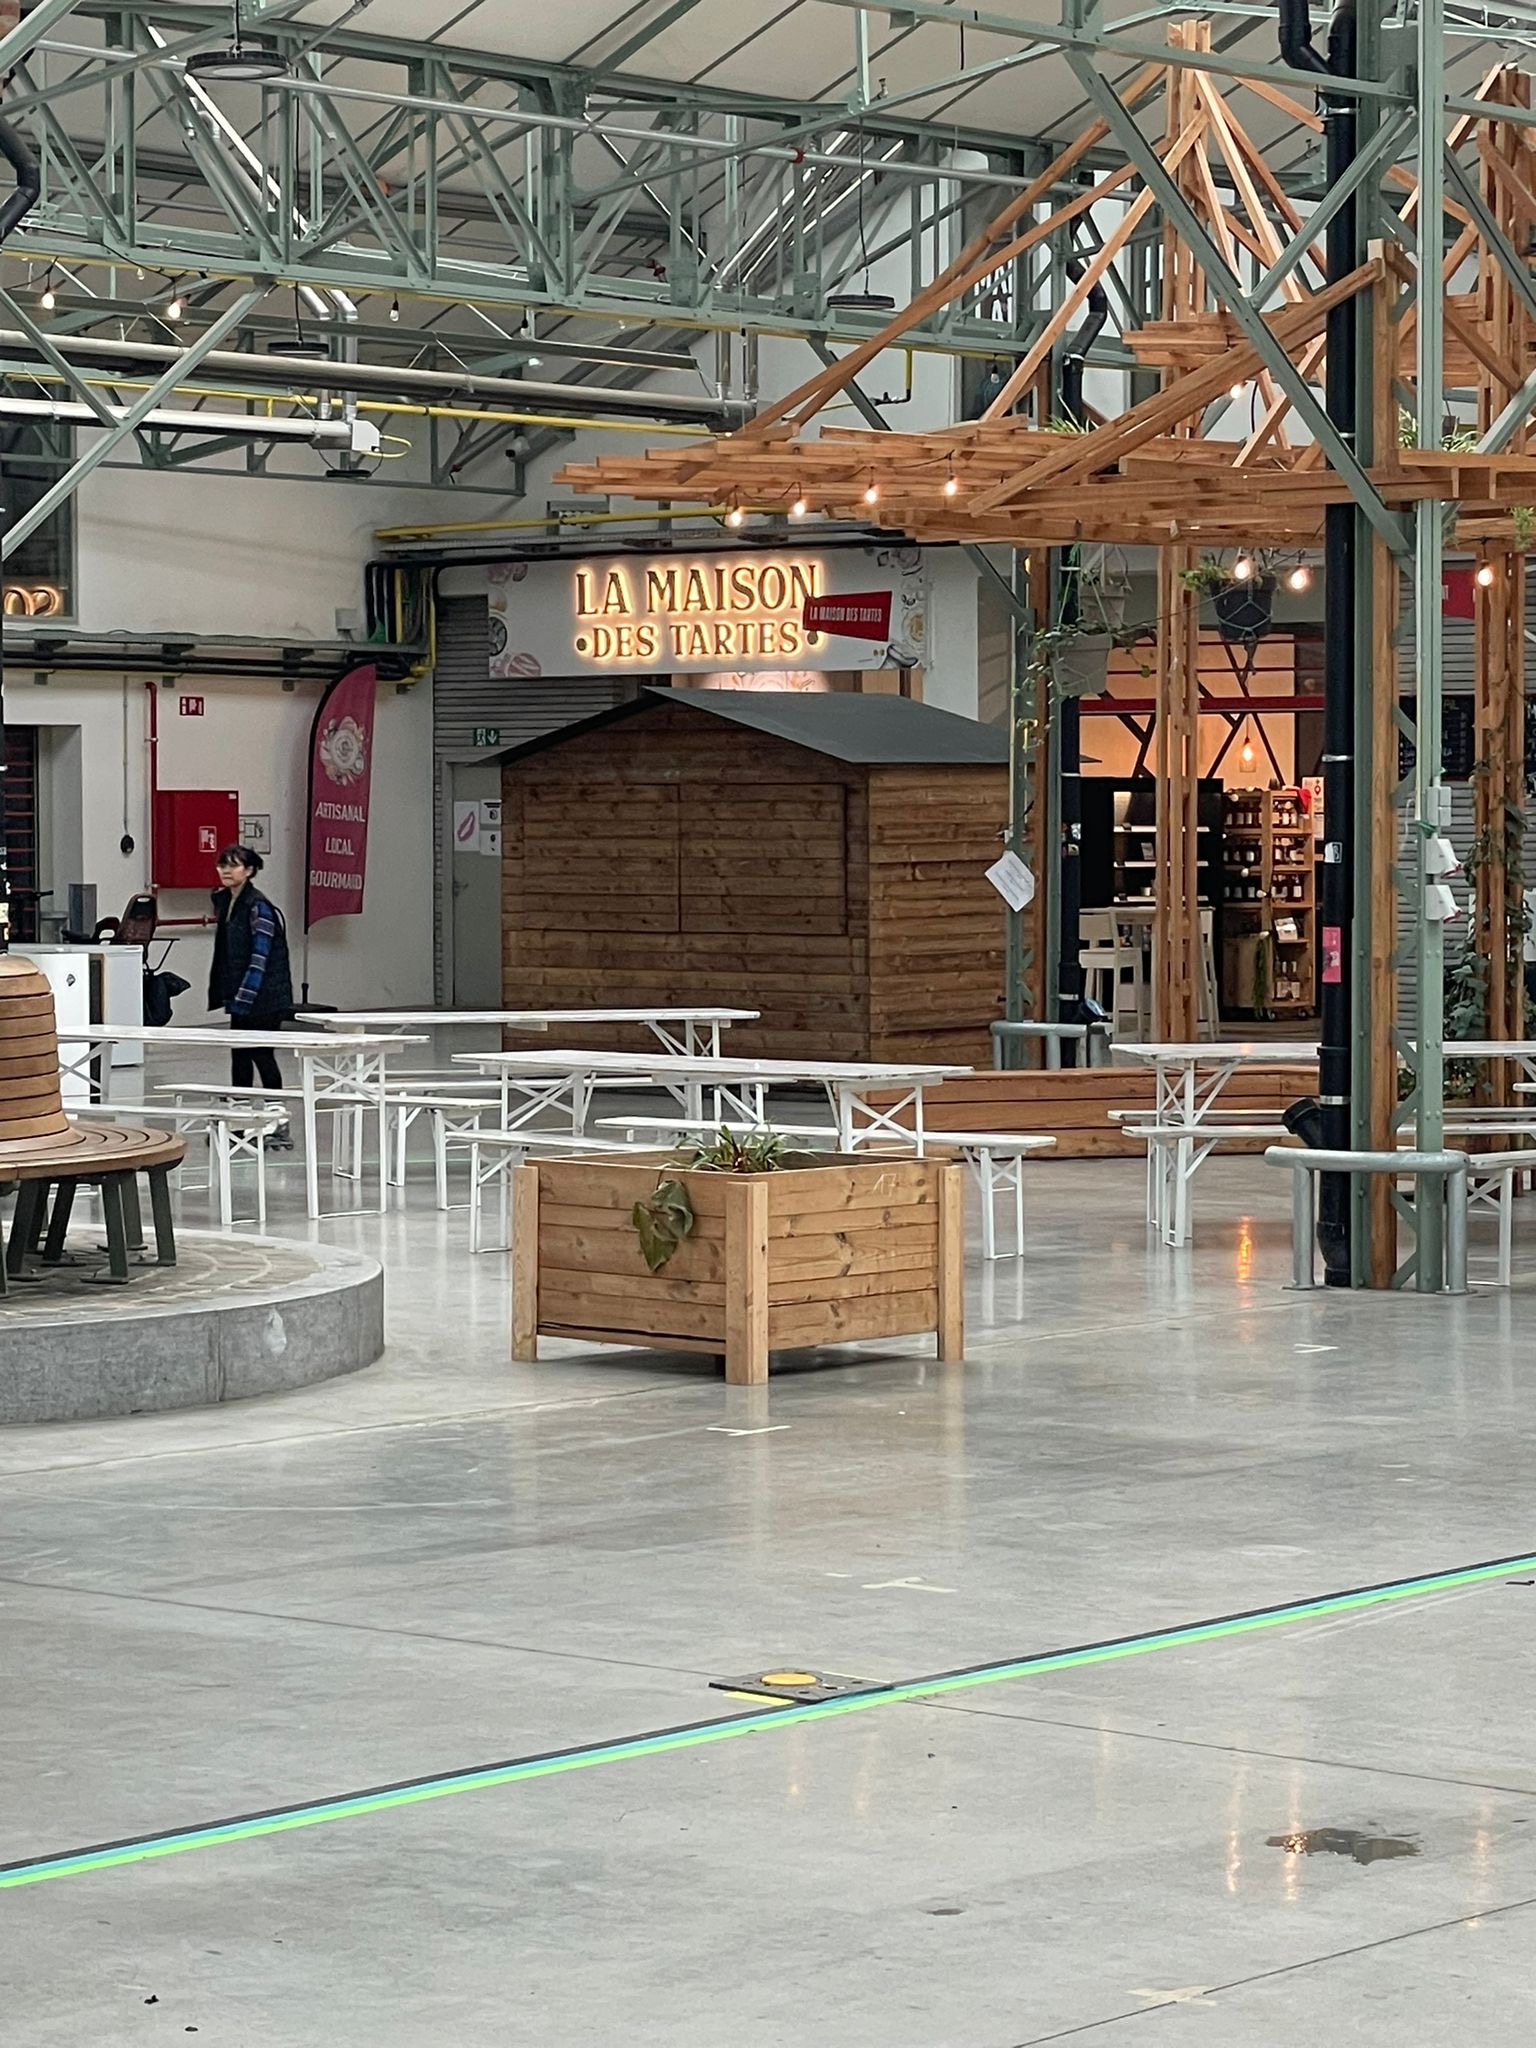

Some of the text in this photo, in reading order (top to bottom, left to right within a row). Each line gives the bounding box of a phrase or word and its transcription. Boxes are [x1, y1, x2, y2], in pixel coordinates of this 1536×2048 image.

[576, 564, 817, 616] LA MAISON
[809, 605, 882, 623] LA MAISON DES TARTES
[593, 621, 799, 658] DES TARTES
[315, 801, 366, 823] ARTISANAL
[325, 836, 355, 857] LOCAL
